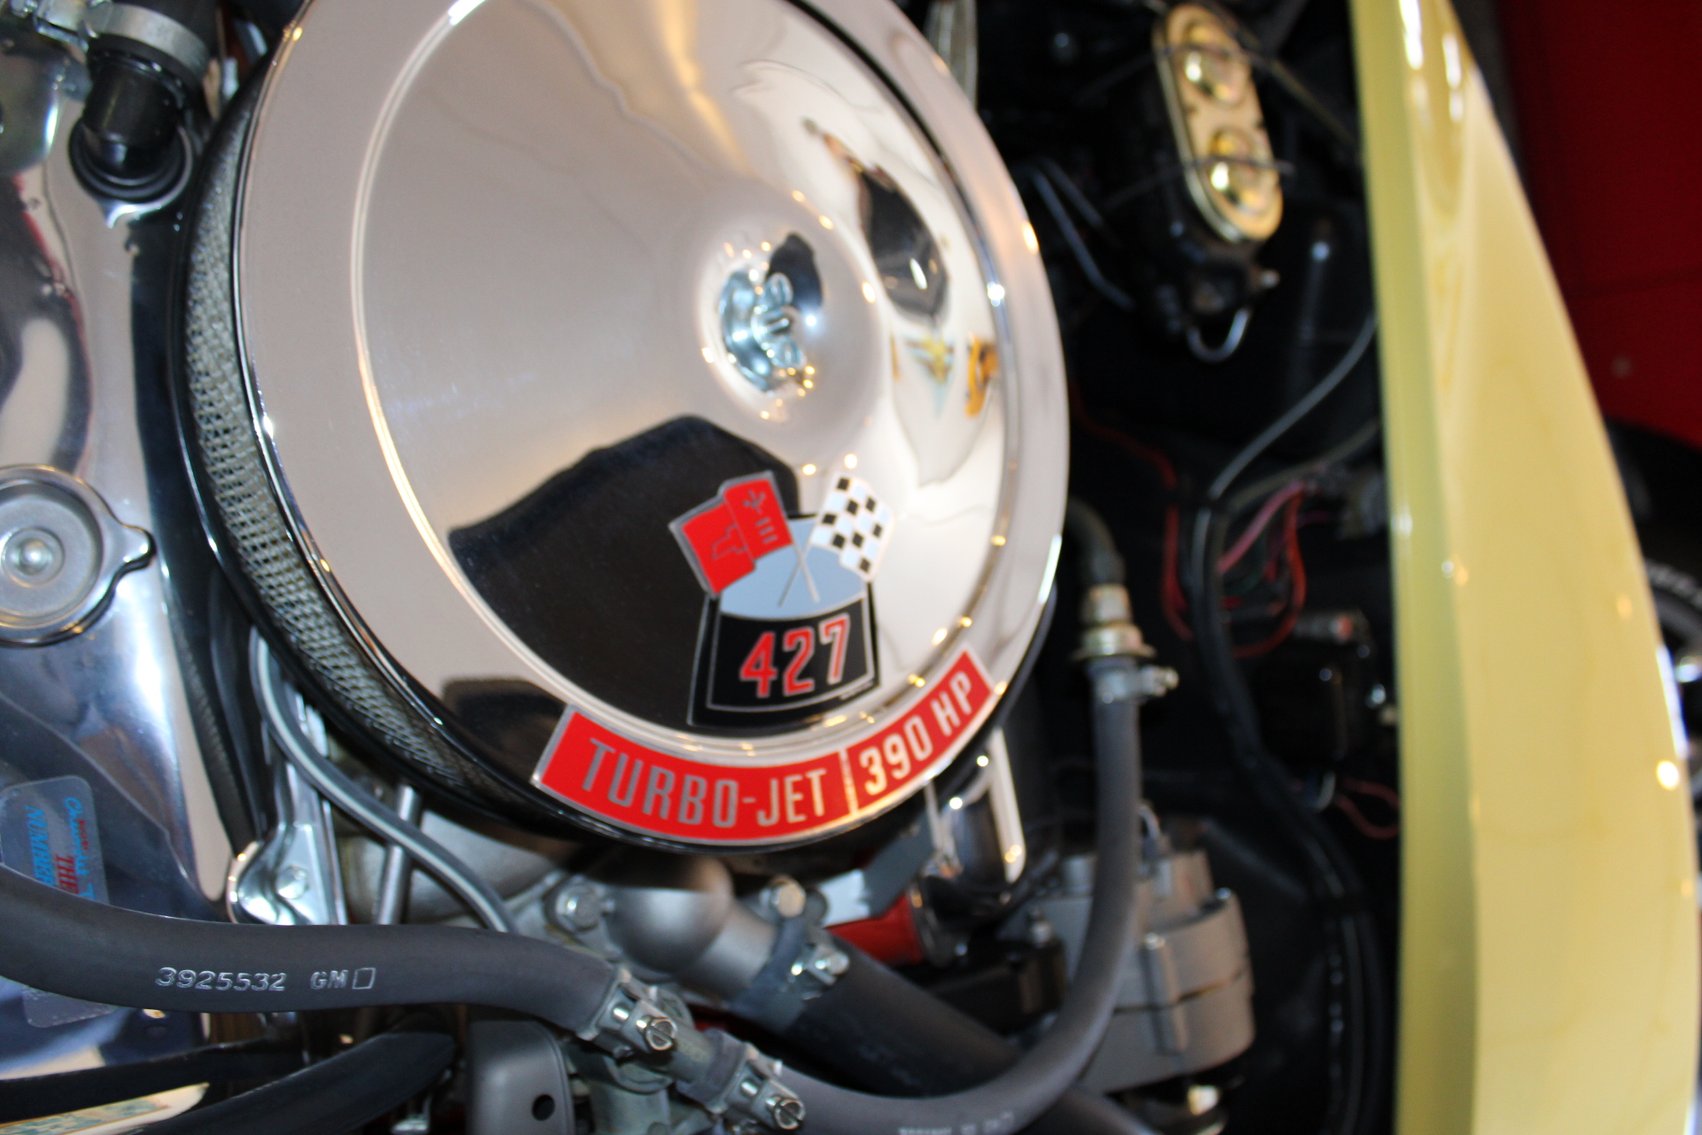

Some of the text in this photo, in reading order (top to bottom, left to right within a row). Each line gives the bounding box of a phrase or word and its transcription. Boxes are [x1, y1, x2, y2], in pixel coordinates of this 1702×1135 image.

[740, 614, 850, 697] 427
[581, 671, 973, 828] TURBO-JET 390 HP
[154, 966, 349, 992] 3925532 GM
